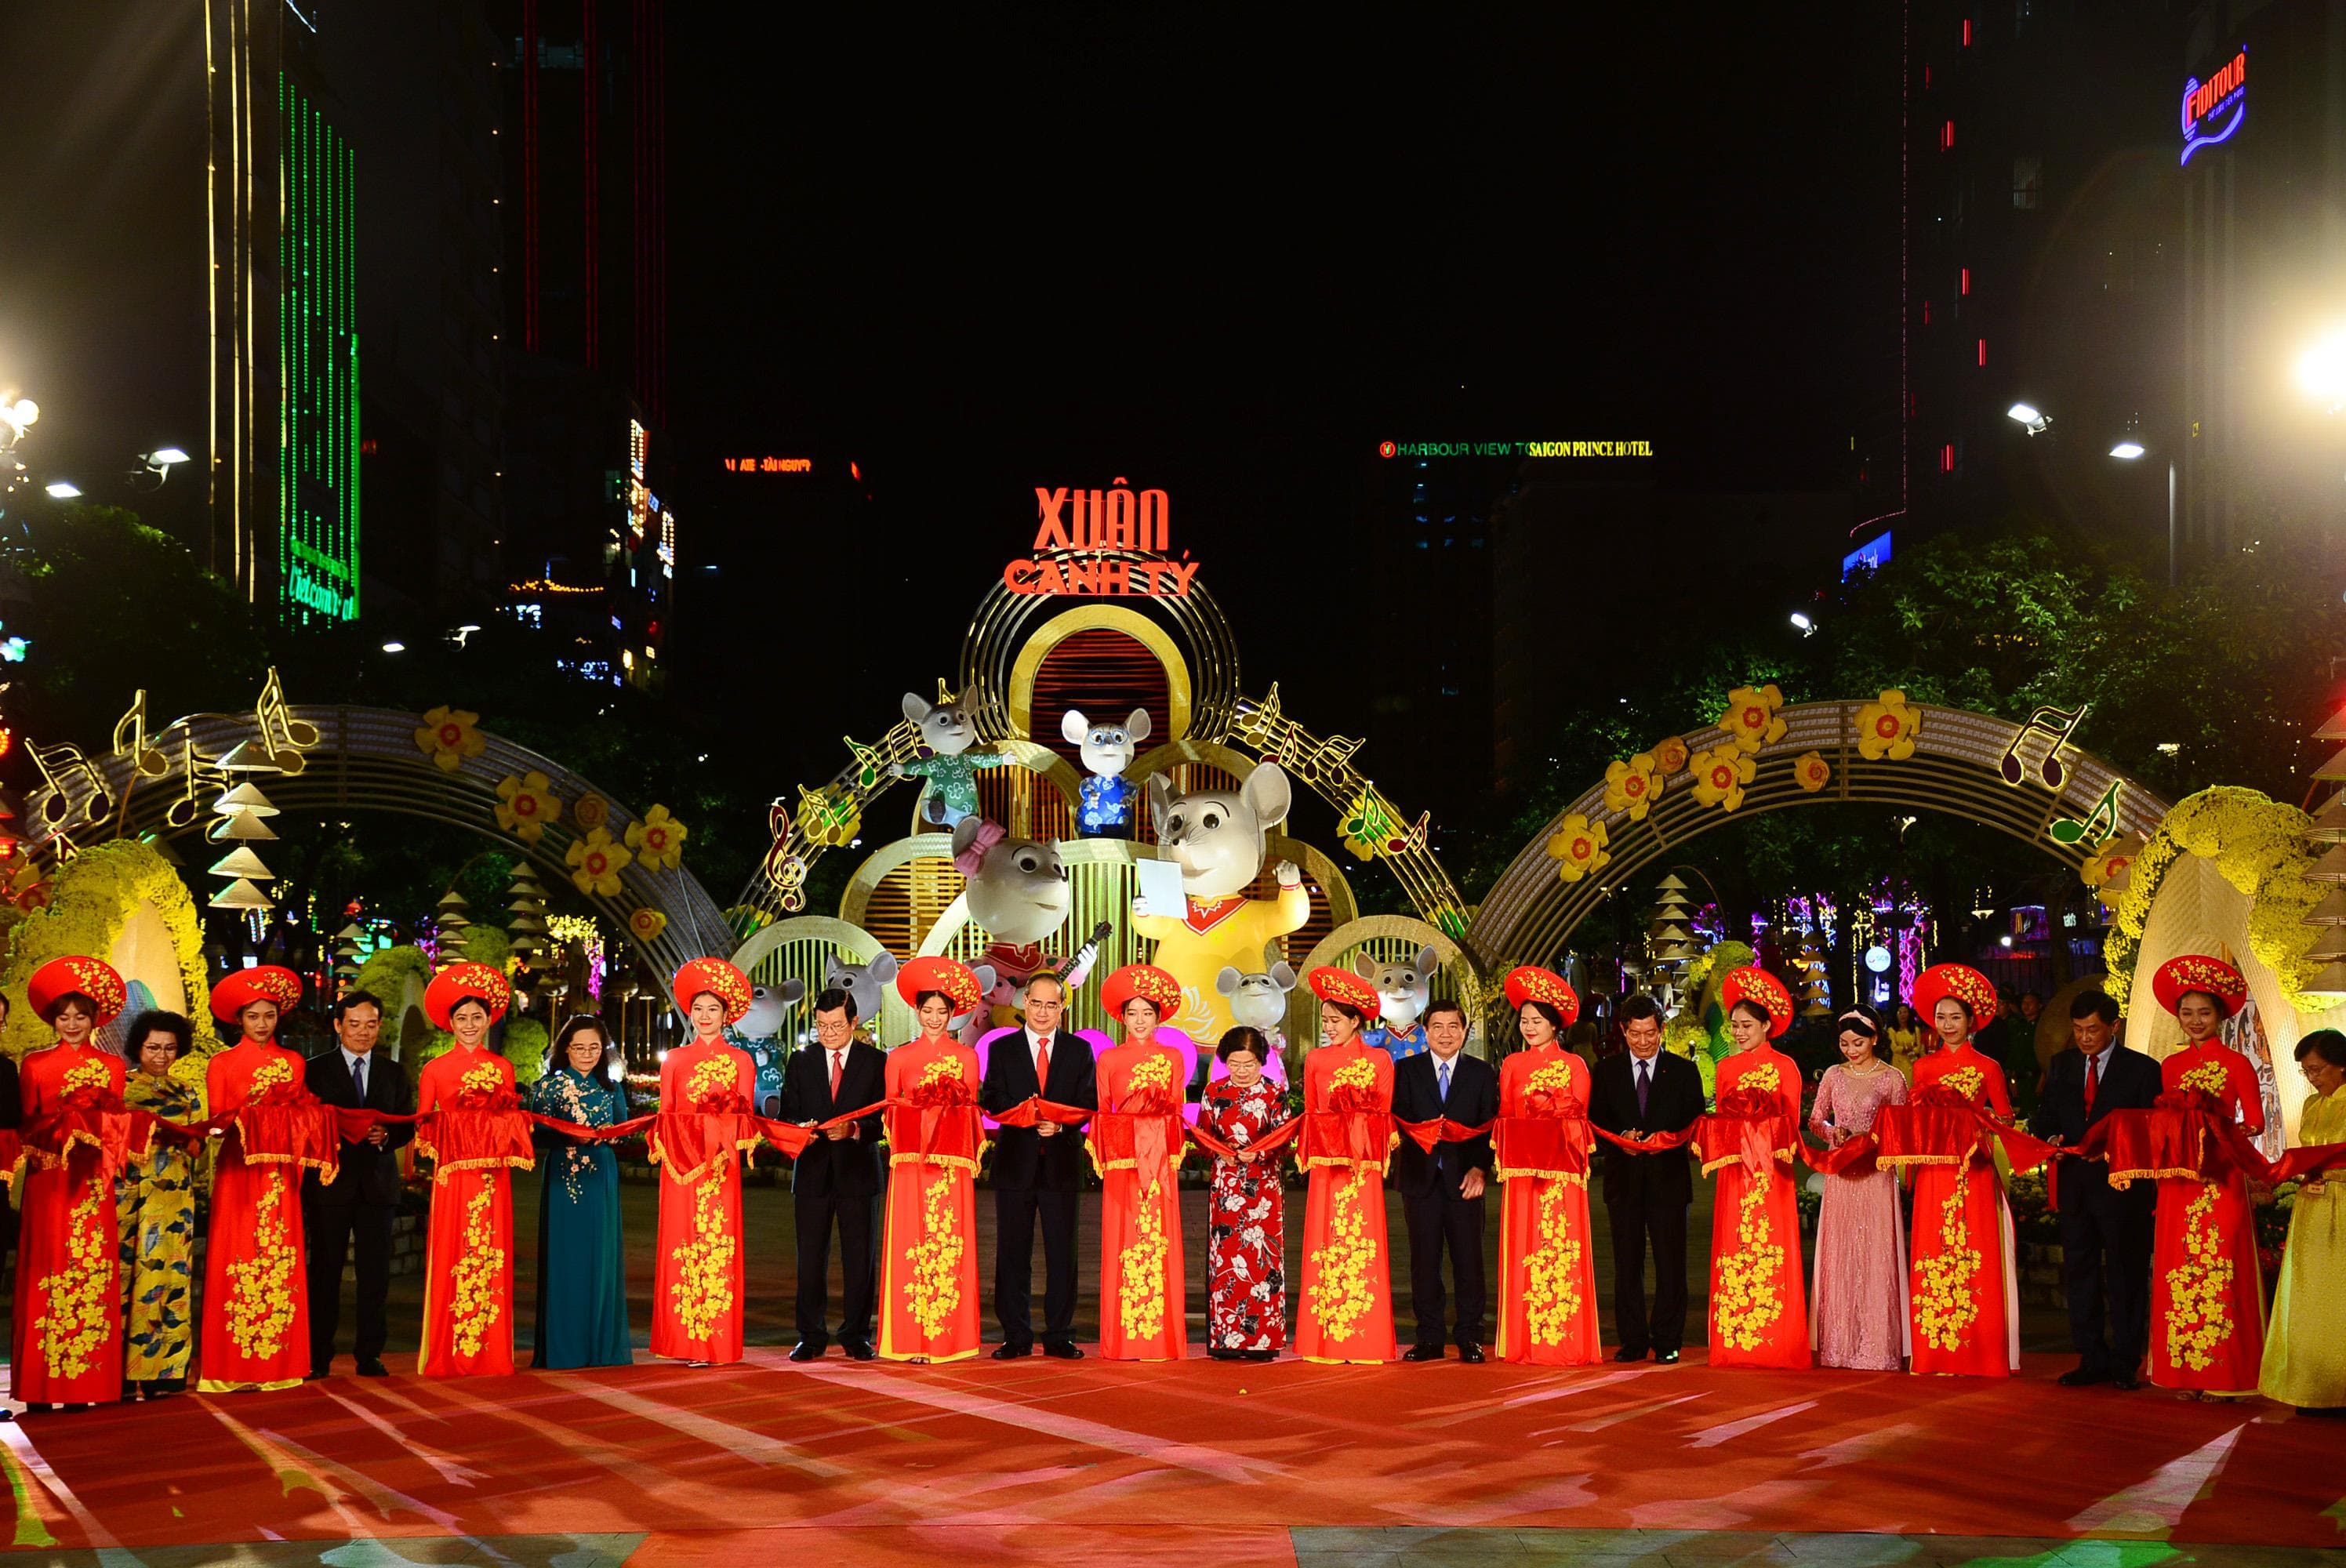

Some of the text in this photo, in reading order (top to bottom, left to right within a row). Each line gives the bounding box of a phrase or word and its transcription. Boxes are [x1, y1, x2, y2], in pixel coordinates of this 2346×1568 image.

[2186, 53, 2245, 129] FIDITOUR
[1396, 442, 1469, 456] HARBOUR
[1473, 442, 1511, 456] VIEW
[1529, 441, 1653, 457] SAIGON PRINCE HOTEL
[1033, 477, 1168, 550] XUÂN
[1004, 549, 1200, 596] CANH TÝ
